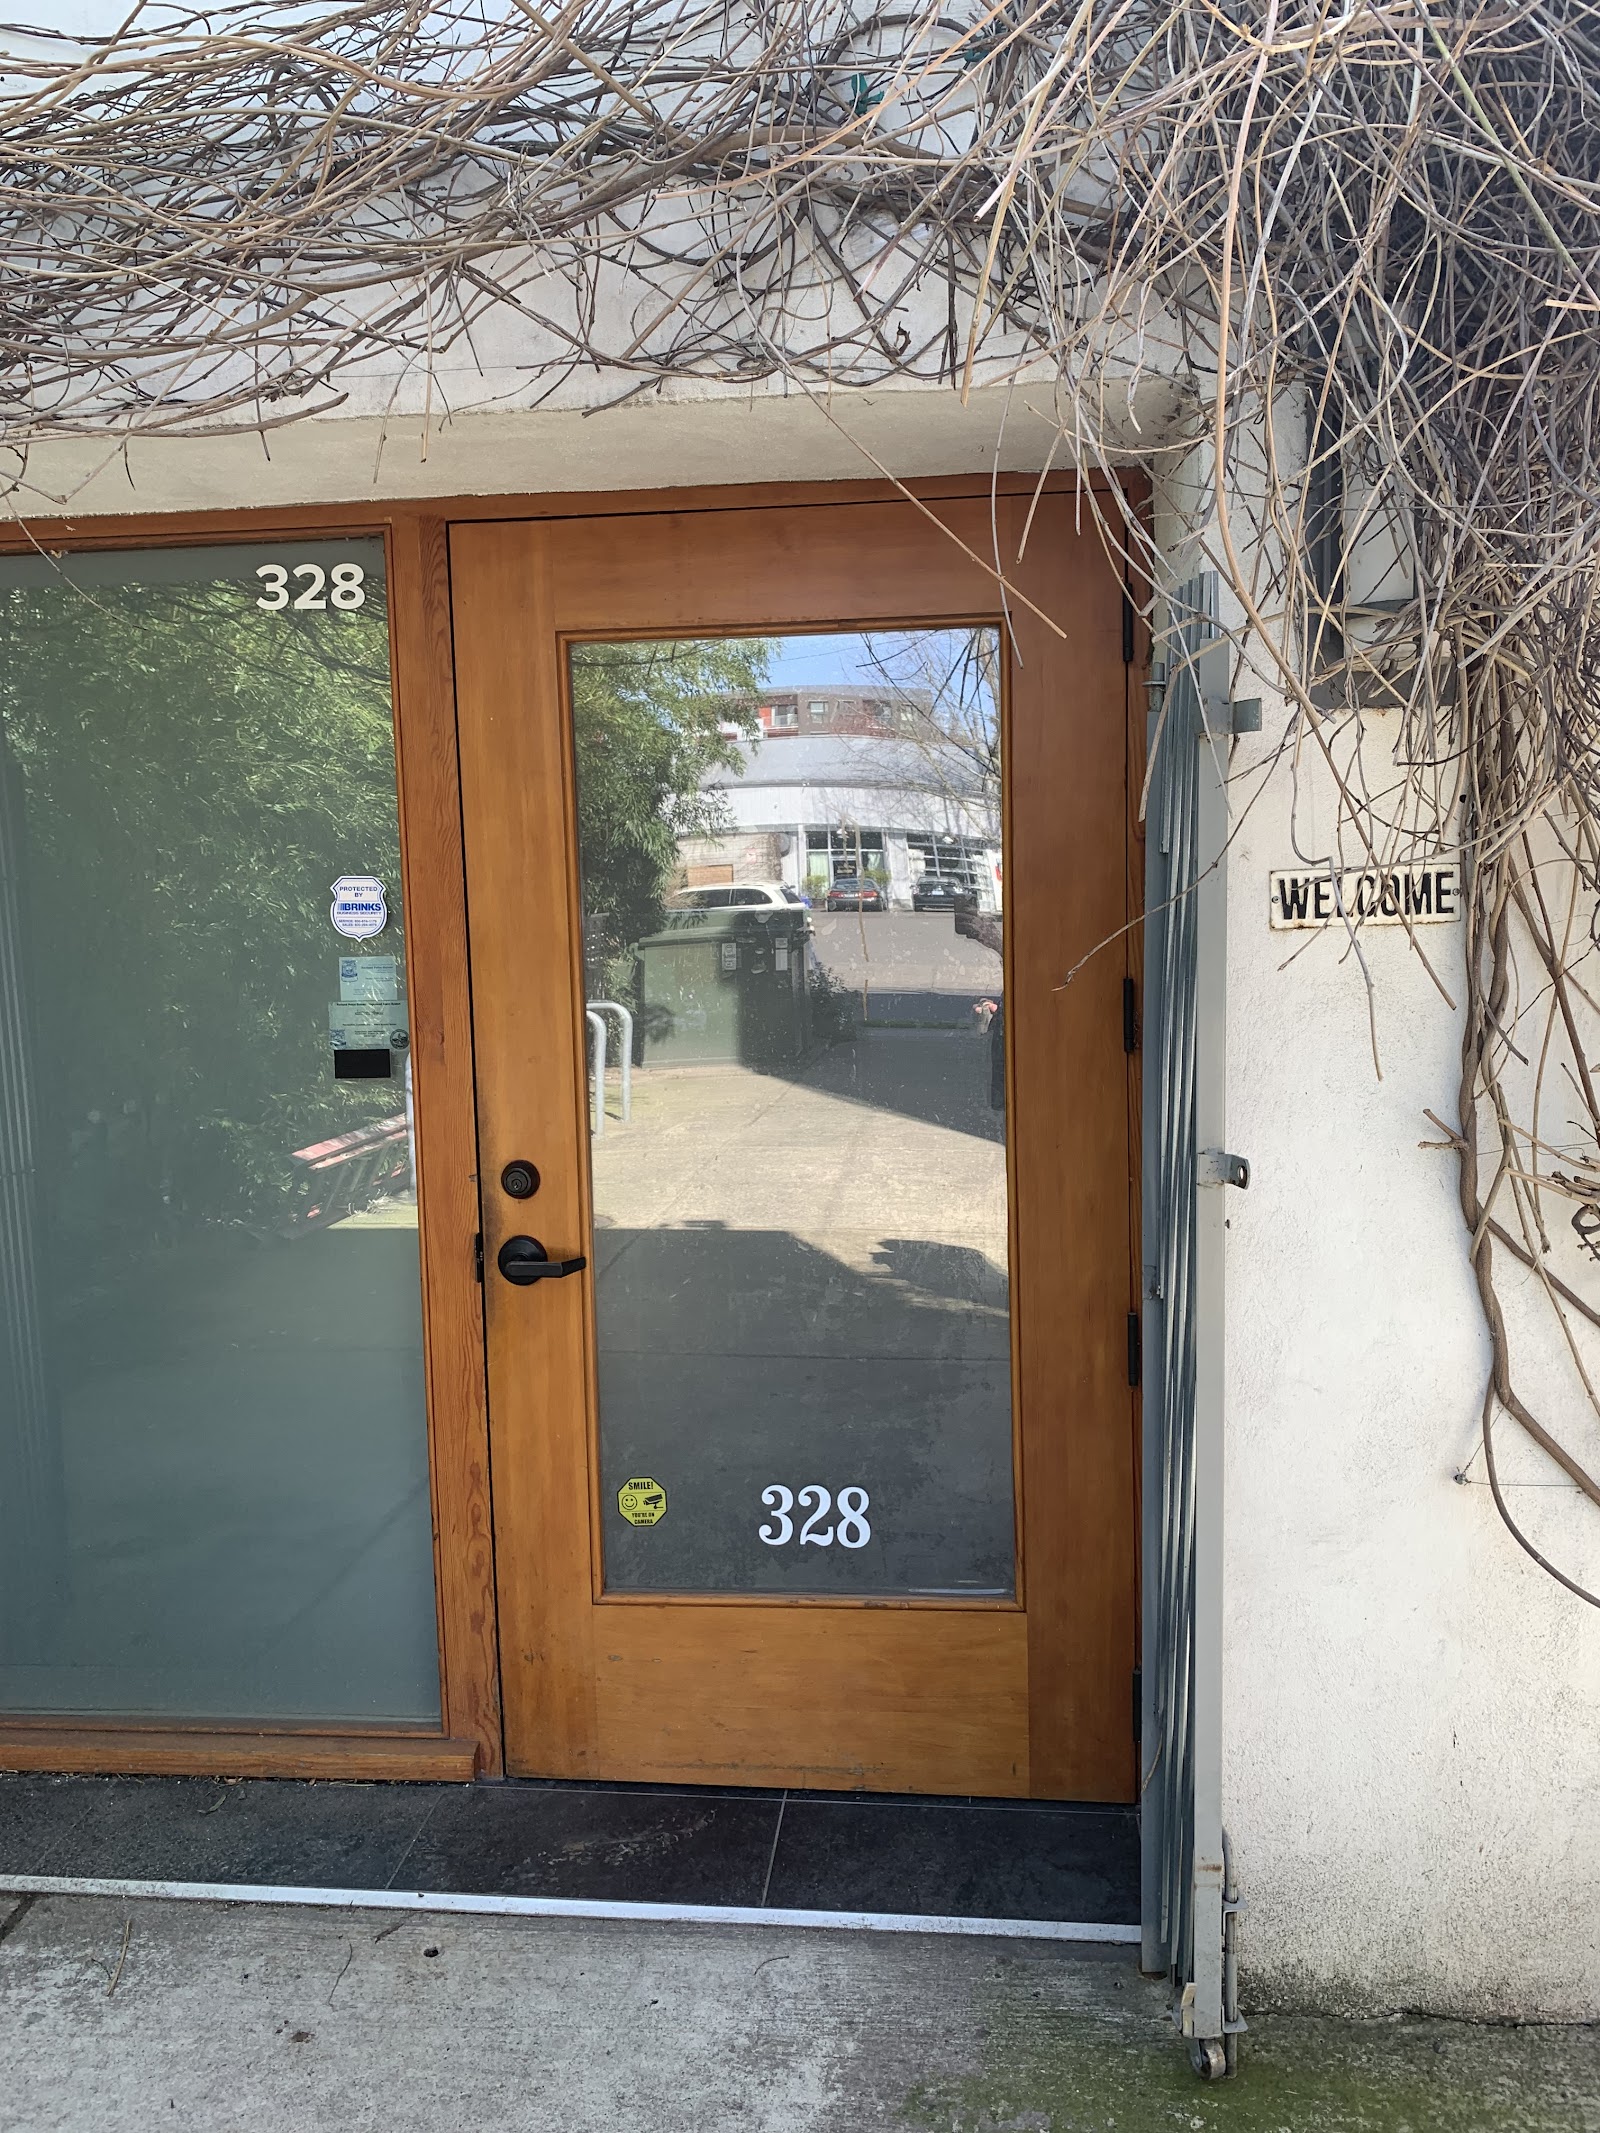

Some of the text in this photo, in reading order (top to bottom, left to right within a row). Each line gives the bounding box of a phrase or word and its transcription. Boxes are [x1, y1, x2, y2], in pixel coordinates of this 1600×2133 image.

[255, 563, 365, 610] 328
[344, 903, 381, 911] BRINKS
[628, 1481, 654, 1490] SMILE!
[758, 1484, 871, 1548] 328
